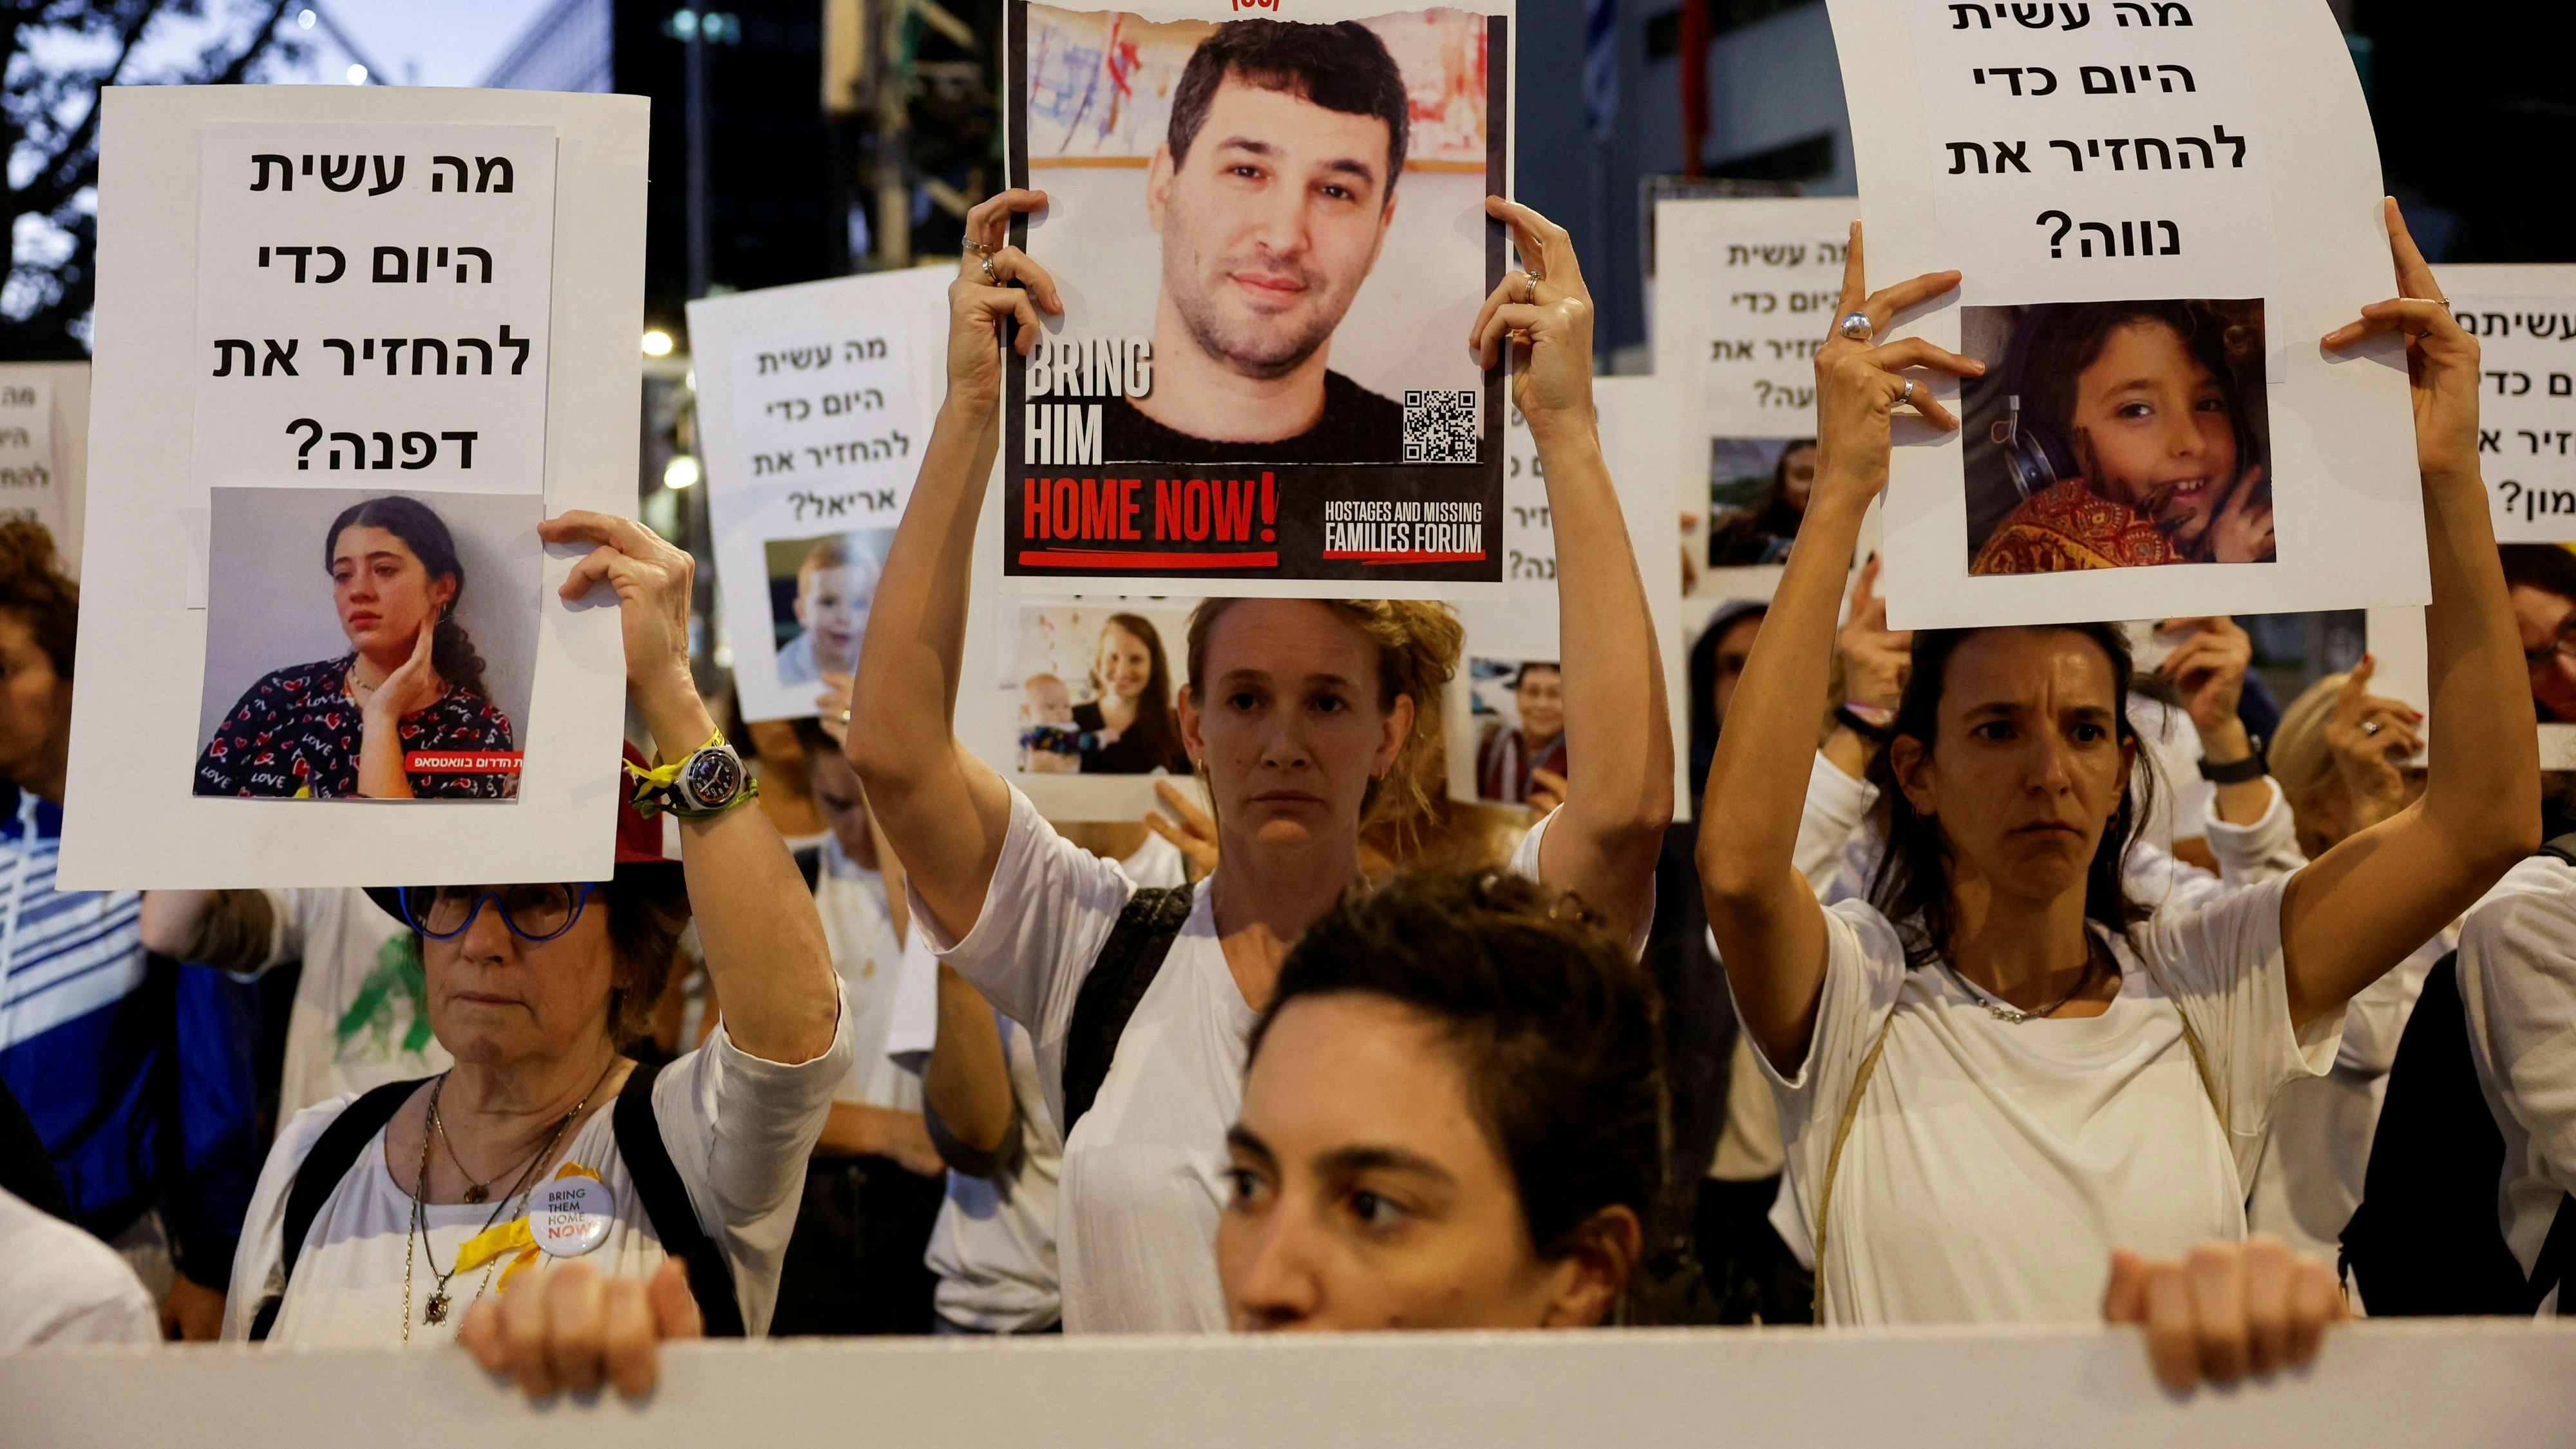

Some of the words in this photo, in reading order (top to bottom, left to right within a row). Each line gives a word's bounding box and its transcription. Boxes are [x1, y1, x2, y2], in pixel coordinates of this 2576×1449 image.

[1948, 3, 2090, 32] עשית
[2112, 2, 2193, 27] מה
[1973, 67, 2058, 96] כדי
[2079, 64, 2196, 95] היום
[1945, 140, 2032, 175] את
[2049, 124, 2246, 172] להחזיר
[249, 154, 405, 197] עשית
[431, 155, 514, 193] מה
[2036, 210, 2181, 259] נווה?
[258, 246, 346, 284] כדי
[372, 246, 493, 283] היום
[1728, 245, 1805, 267] עשית
[1732, 293, 1777, 314] כדי
[212, 339, 299, 377] את
[323, 325, 530, 376] להחזיר
[757, 346, 831, 375] עשית
[846, 337, 887, 361] מה
[1712, 340, 1754, 360] את
[1025, 336, 1150, 397] BRING
[1753, 380, 1814, 408] עה?
[2478, 372, 2532, 395] כד
[766, 399, 811, 421] כדי
[822, 388, 884, 416] היום
[285, 418, 478, 470] דפנה?
[807, 430, 909, 468] להחזיר
[1025, 404, 1103, 465] HIM
[753, 453, 793, 475] את
[788, 489, 896, 518] אריאל?
[1024, 478, 1141, 540] HOME
[1155, 472, 1279, 542] NOW!
[1325, 501, 1391, 521] HOSTAGES
[1394, 502, 1420, 522] AND
[1424, 502, 1481, 522] MISSING
[2499, 480, 2576, 522] מון?
[1325, 523, 1409, 552] FAMILIES
[1415, 524, 1481, 553] FORUM
[302, 733, 332, 756] LOVE
[201, 766, 232, 789] LOVE
[476, 758, 511, 768] הדרום
[251, 773, 286, 789] LOVE
[549, 1188, 585, 1202] BRING
[549, 1201, 580, 1213] THEM
[548, 1212, 585, 1226] HOME
[549, 1223, 592, 1238] NOW
